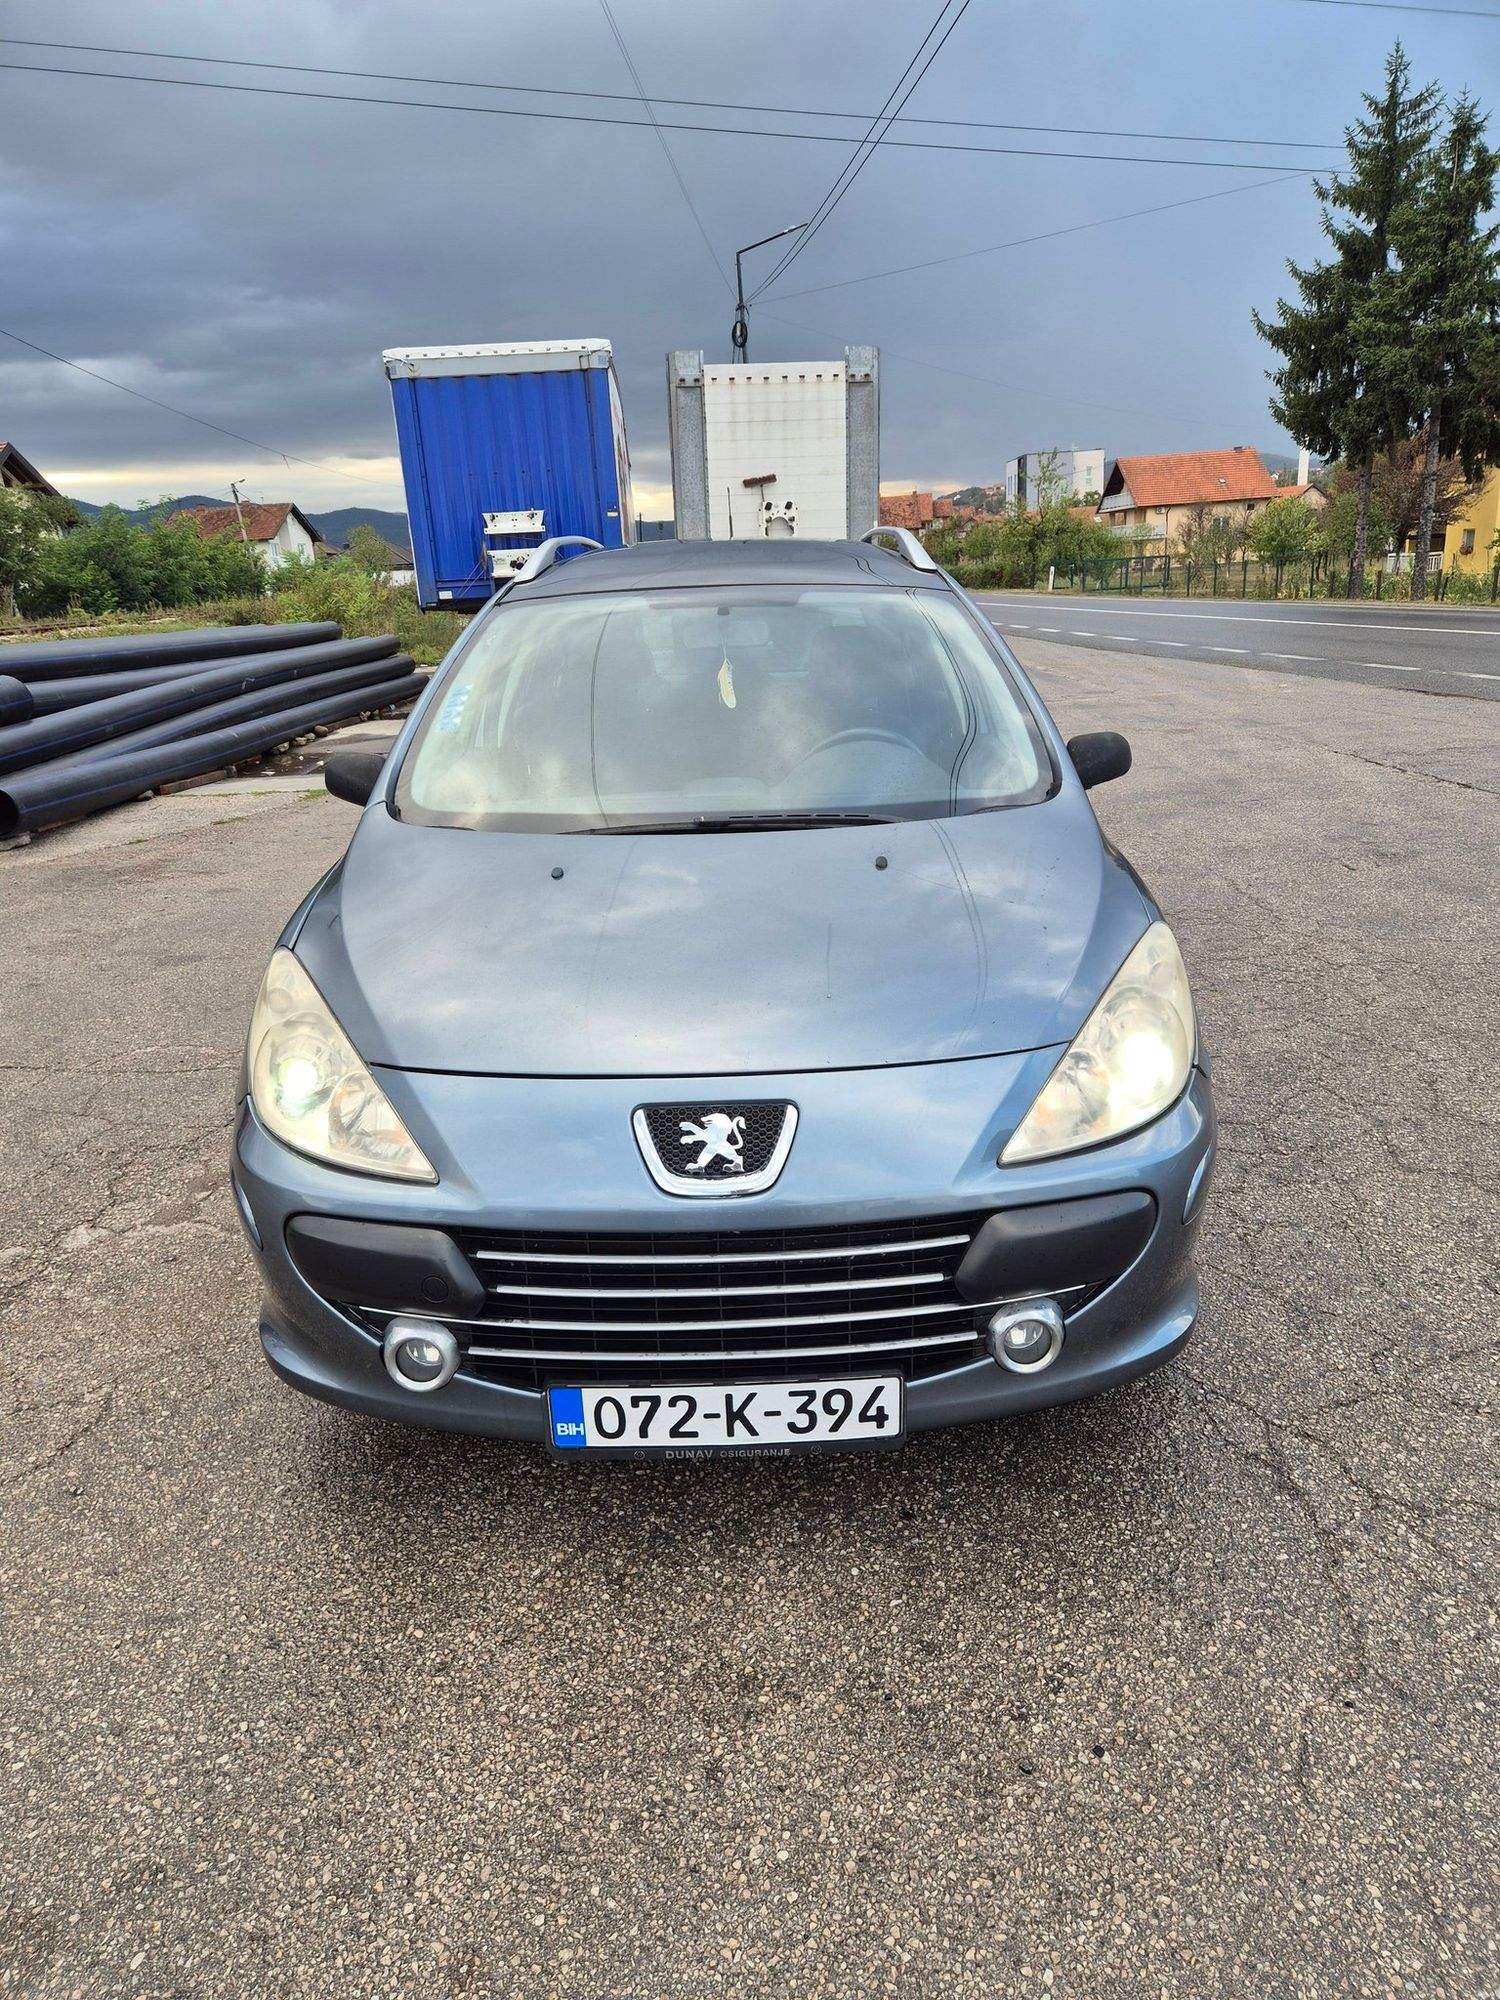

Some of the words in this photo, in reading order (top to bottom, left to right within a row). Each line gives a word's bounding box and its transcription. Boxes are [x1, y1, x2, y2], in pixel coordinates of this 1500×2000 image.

[594, 1385, 890, 1440] 072-K-394
[556, 1422, 585, 1436] BIH
[665, 1450, 714, 1460] DUNAV
[719, 1448, 792, 1459] OSIGURANJE
